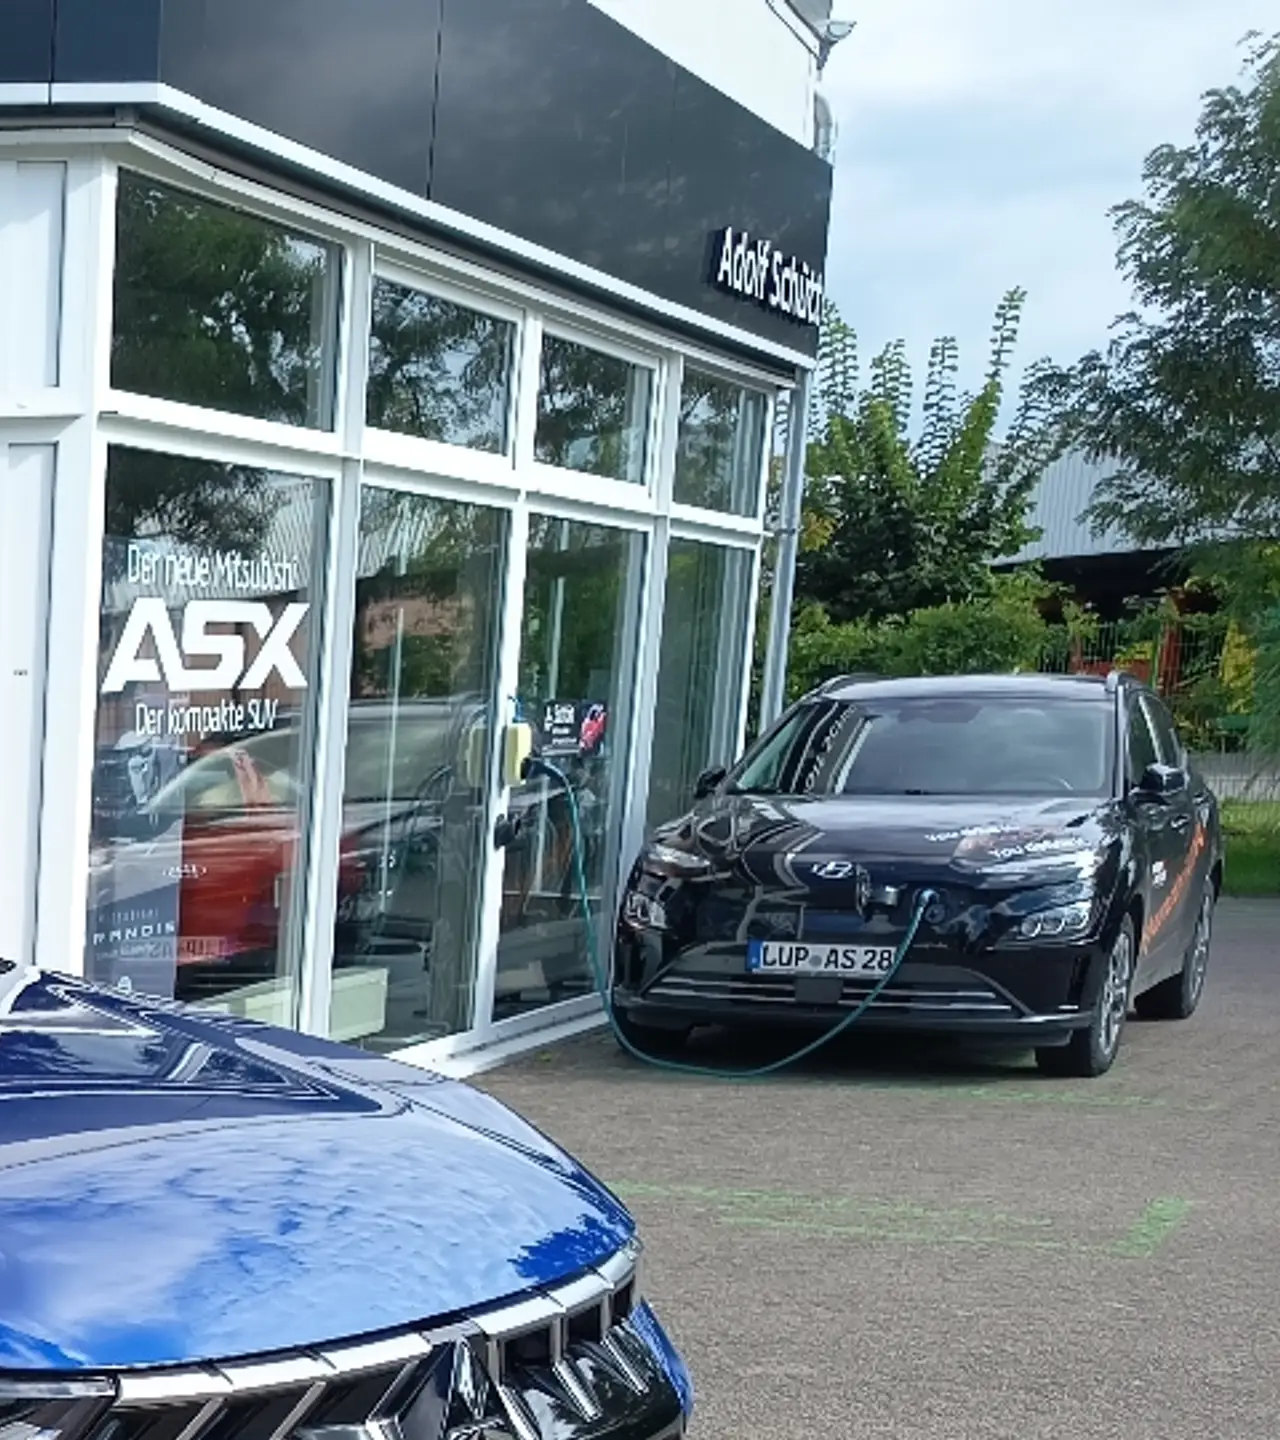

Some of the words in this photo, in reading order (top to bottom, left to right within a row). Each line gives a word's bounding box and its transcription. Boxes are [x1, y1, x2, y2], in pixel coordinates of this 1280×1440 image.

[718, 226, 771, 300] Adolf
[127, 543, 159, 584] Der
[165, 553, 209, 587] neue
[215, 549, 298, 590] Mitsubishi
[100, 597, 310, 693] ASX
[136, 702, 164, 736] Der
[168, 698, 243, 739] kompakte
[248, 698, 279, 729] SUV
[762, 945, 809, 967] LUP
[824, 948, 855, 969] AS
[861, 949, 892, 971] 28
